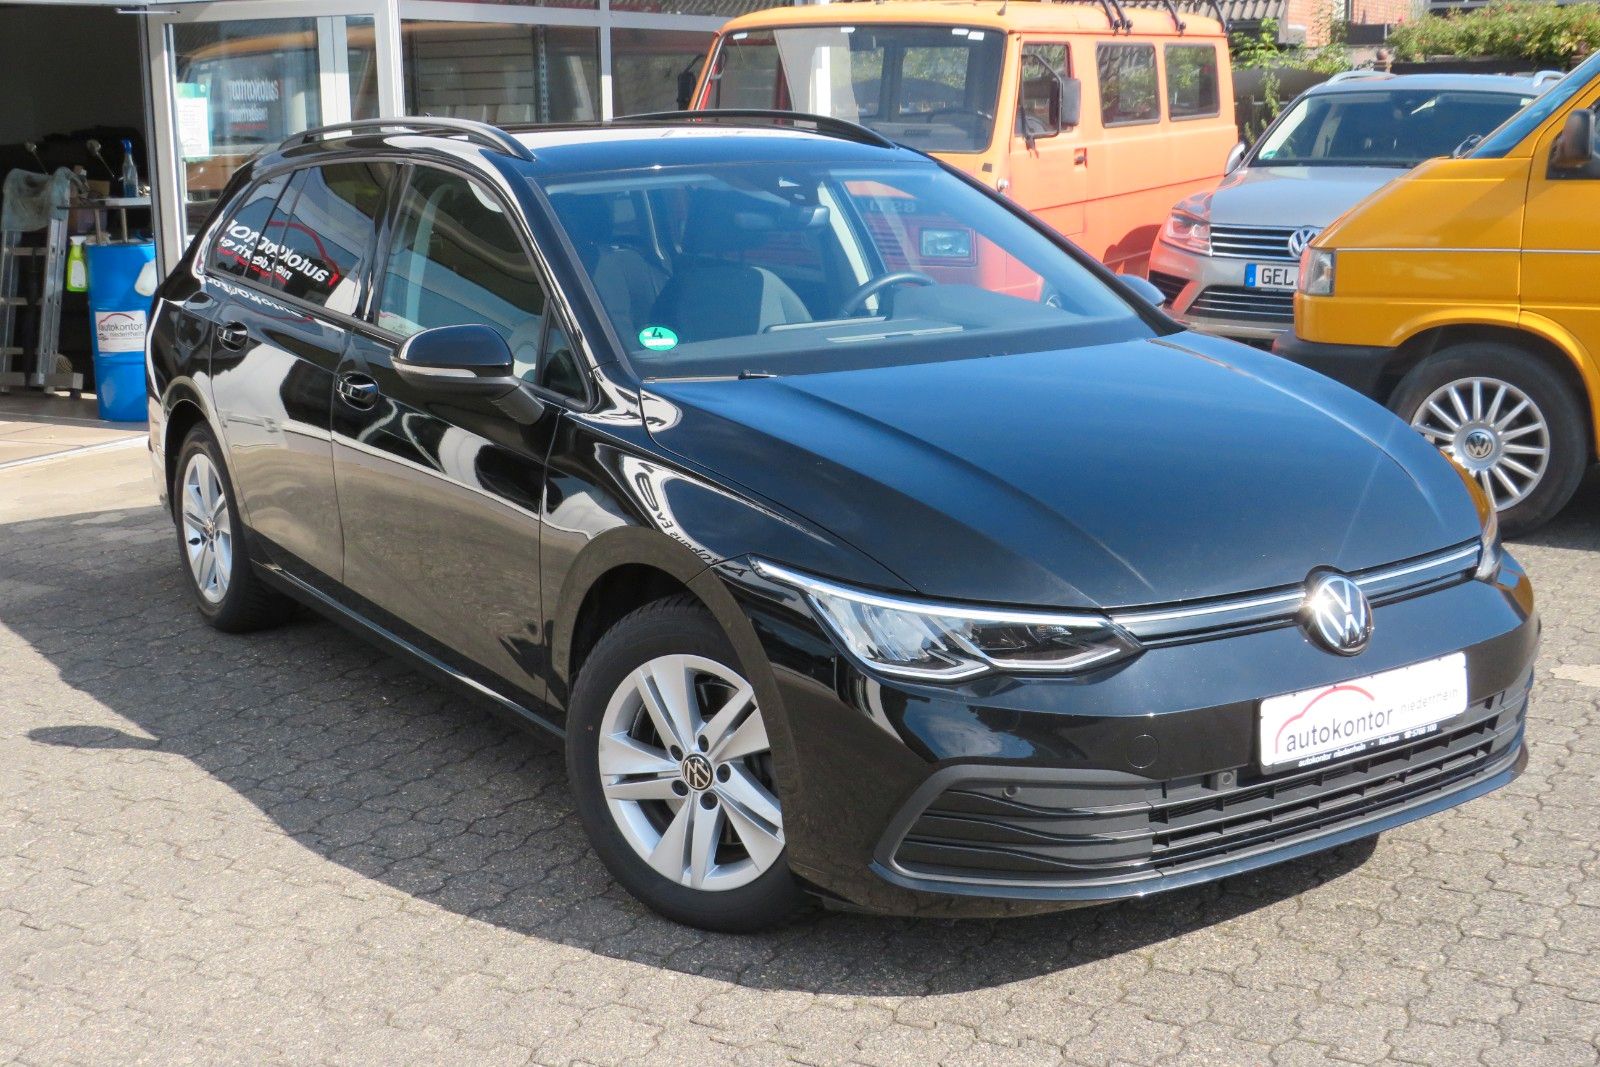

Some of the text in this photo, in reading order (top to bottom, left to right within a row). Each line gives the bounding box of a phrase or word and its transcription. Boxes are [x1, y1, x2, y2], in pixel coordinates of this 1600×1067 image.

[1261, 268, 1294, 286] GEL
[652, 328, 664, 339] 4
[1286, 708, 1394, 752] autokontor
